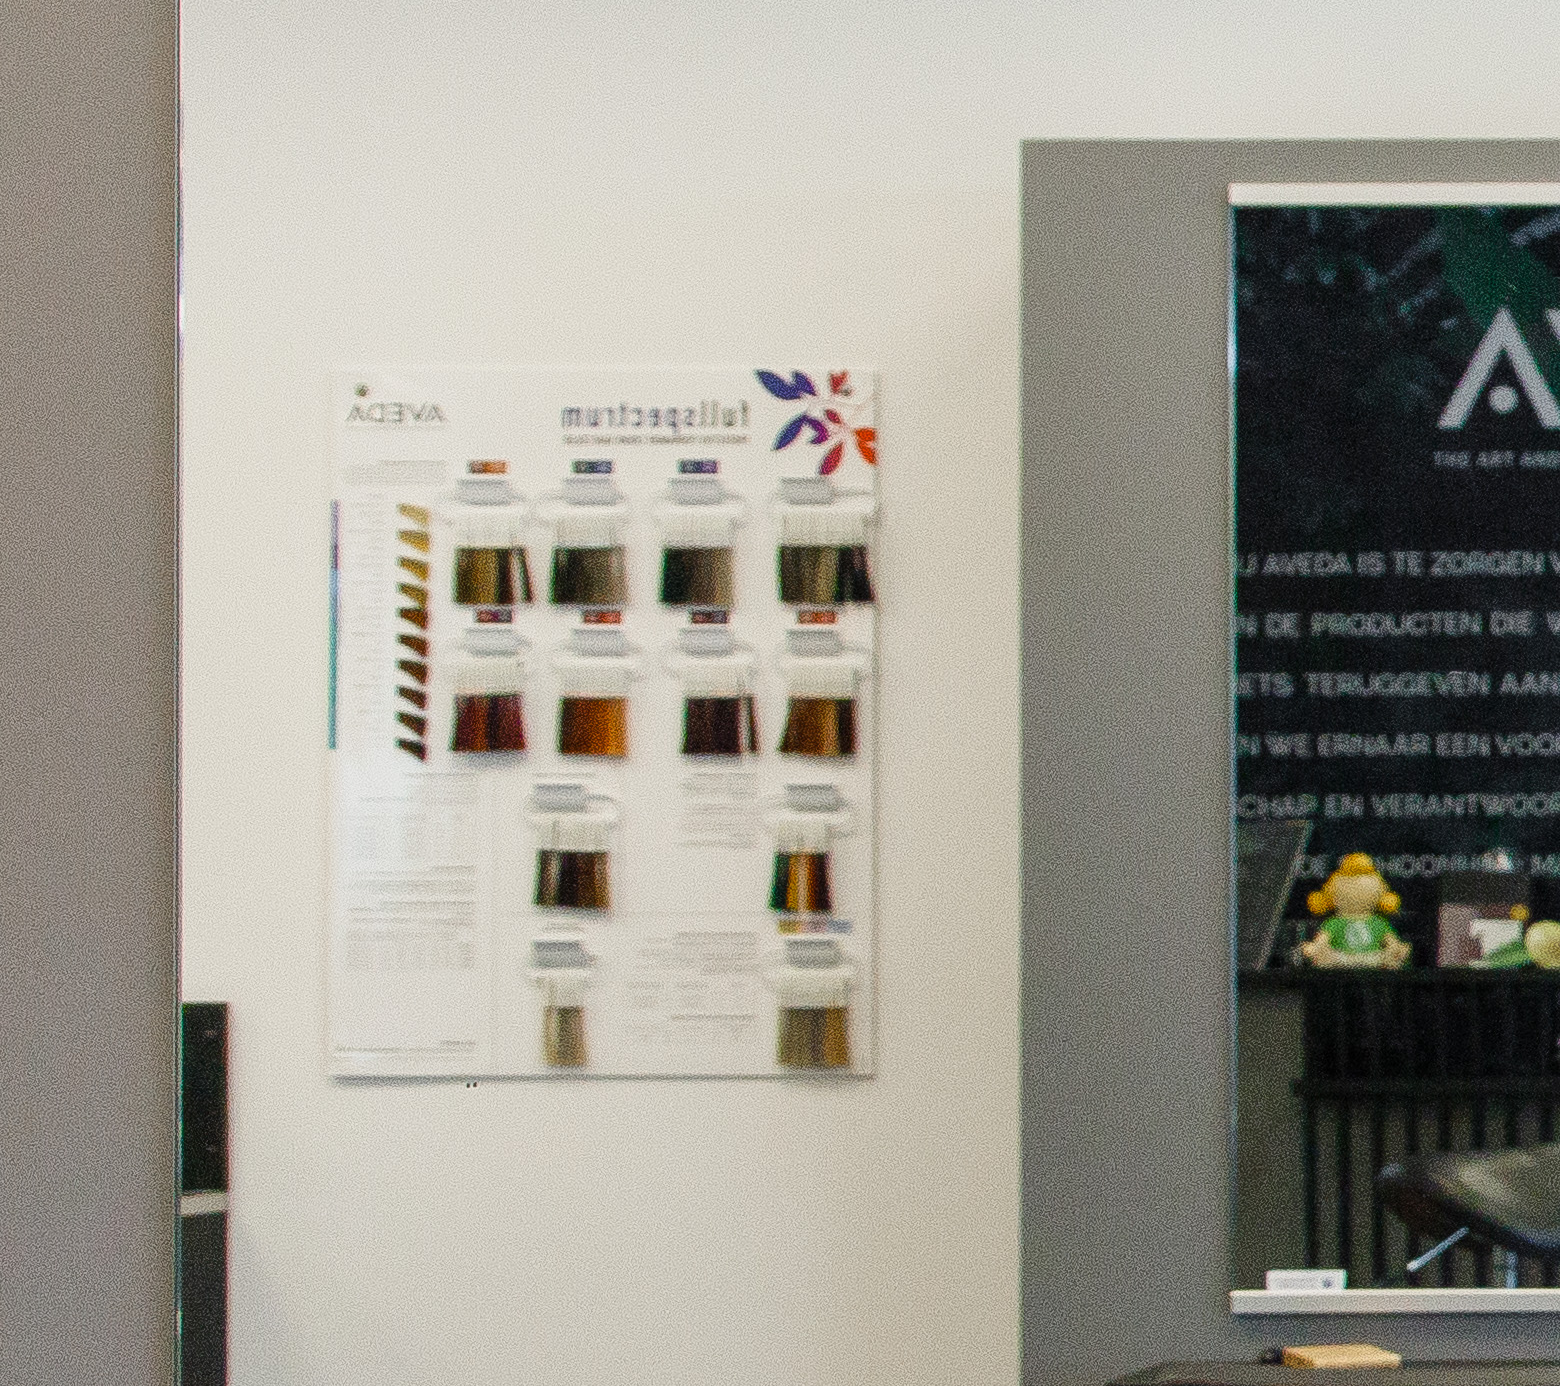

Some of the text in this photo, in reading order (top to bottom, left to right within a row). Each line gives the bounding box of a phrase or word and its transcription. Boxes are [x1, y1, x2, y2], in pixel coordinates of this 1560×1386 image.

[1261, 550, 1352, 575] AVEDA
[1356, 550, 1385, 575] IS
[1391, 550, 1424, 575] TE
[1430, 550, 1544, 575] ZORGEN
[1264, 611, 1302, 638] DE
[1309, 611, 1484, 637] PRODUCTEN
[1490, 611, 1536, 637] DIE
[1303, 671, 1492, 697] TERUGGEVEN
[1264, 732, 1312, 757] WE
[1317, 732, 1431, 757] ERNAAR
[1436, 732, 1491, 757] EEN
